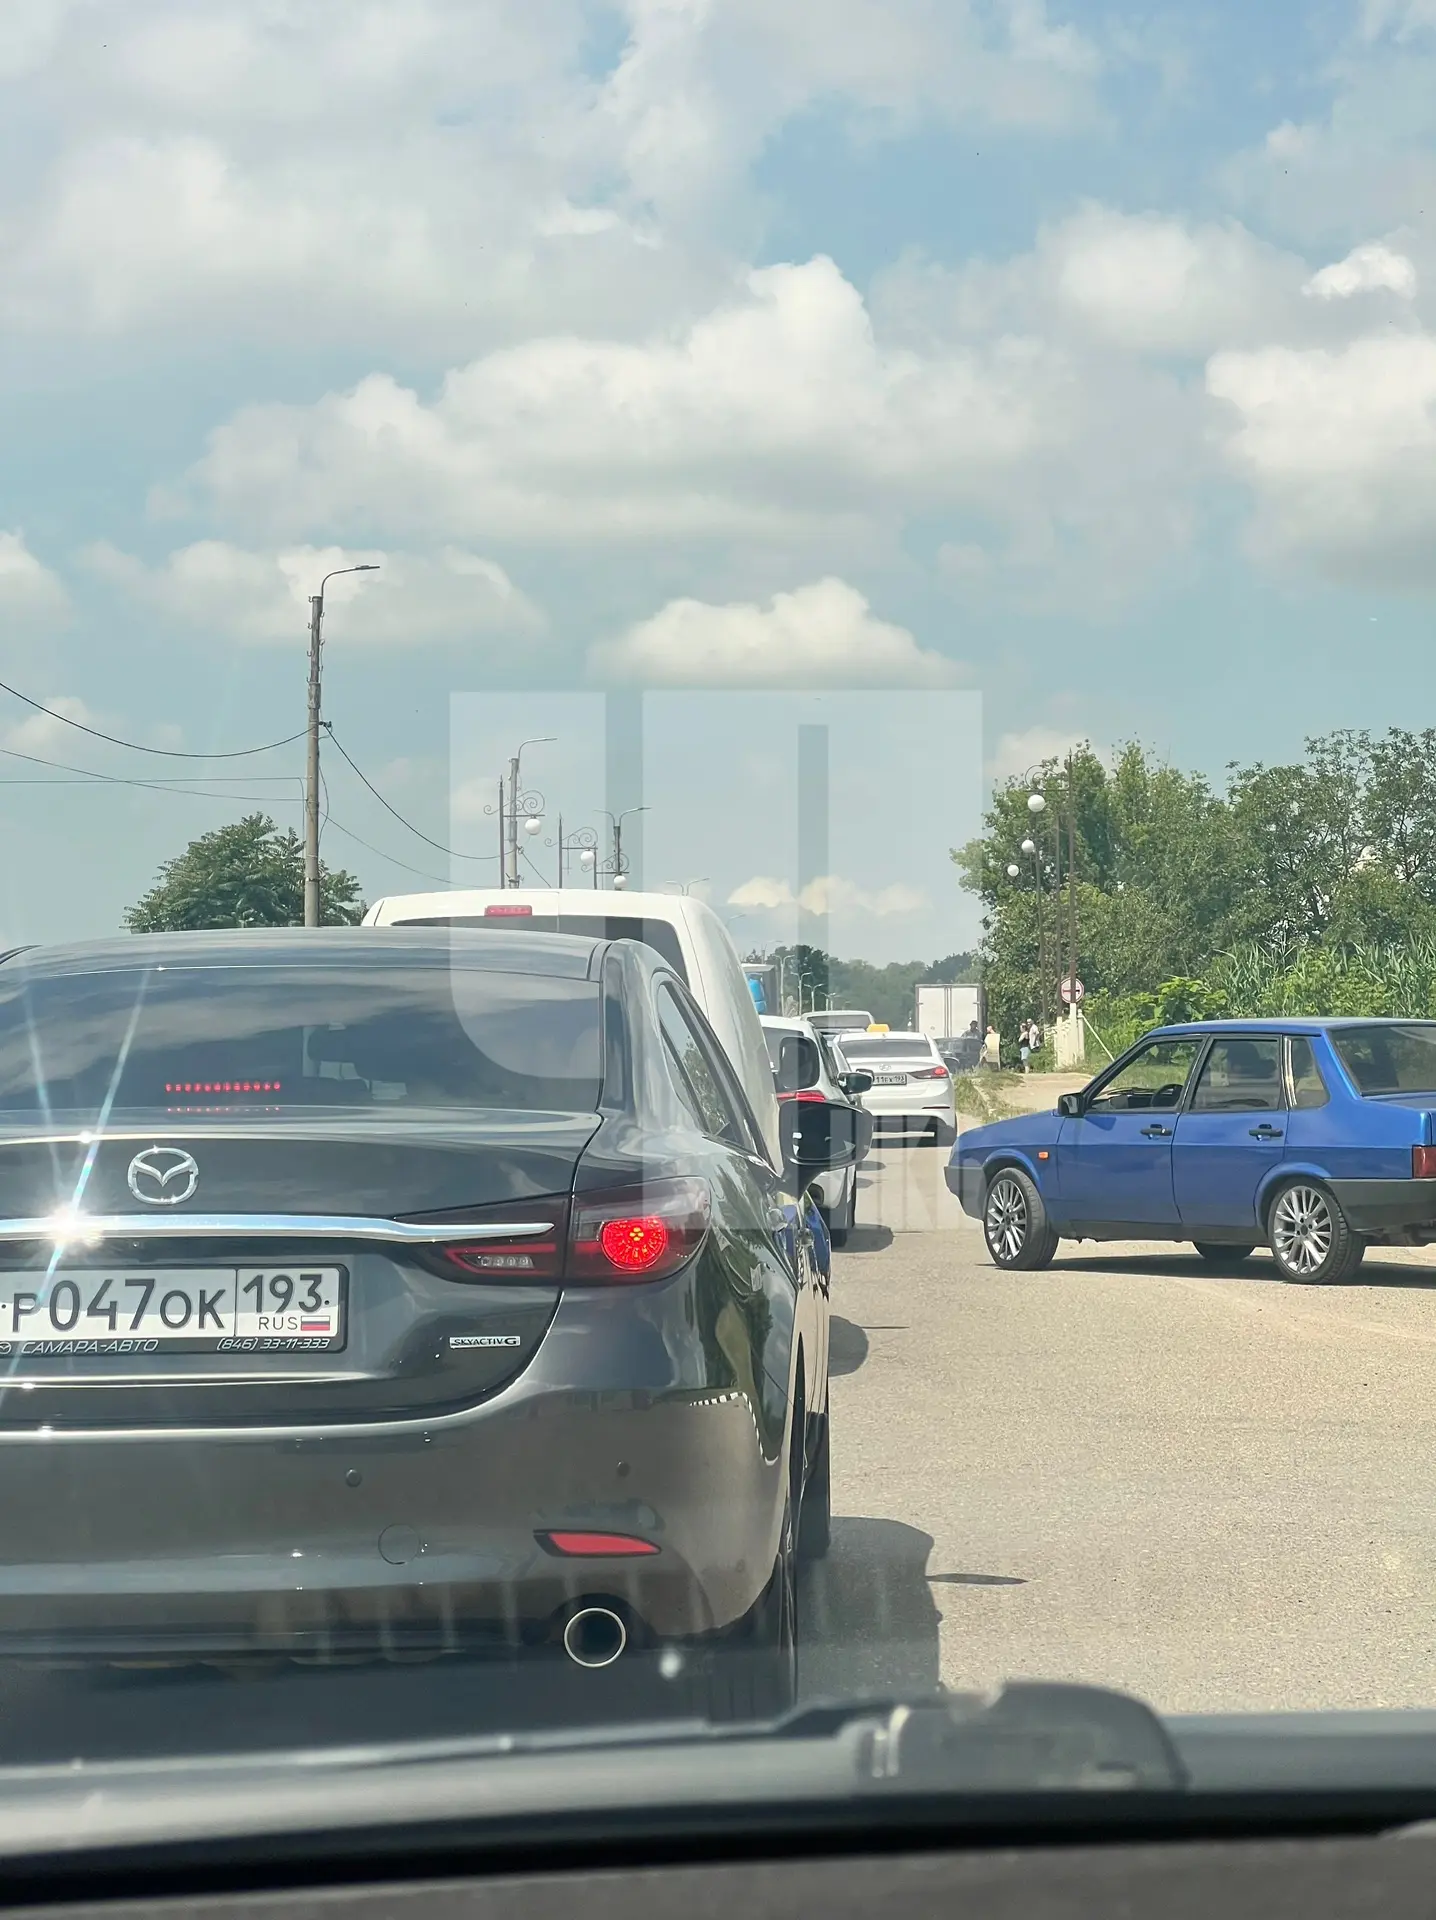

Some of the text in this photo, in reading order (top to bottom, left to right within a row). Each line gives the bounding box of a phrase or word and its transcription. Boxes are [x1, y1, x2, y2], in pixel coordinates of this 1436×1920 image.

[12, 1274, 323, 1332] Р047ОК 193
[258, 1316, 298, 1331] RUS
[20, 1338, 331, 1355] САМАРА-АВТО (846) 33-11-333
